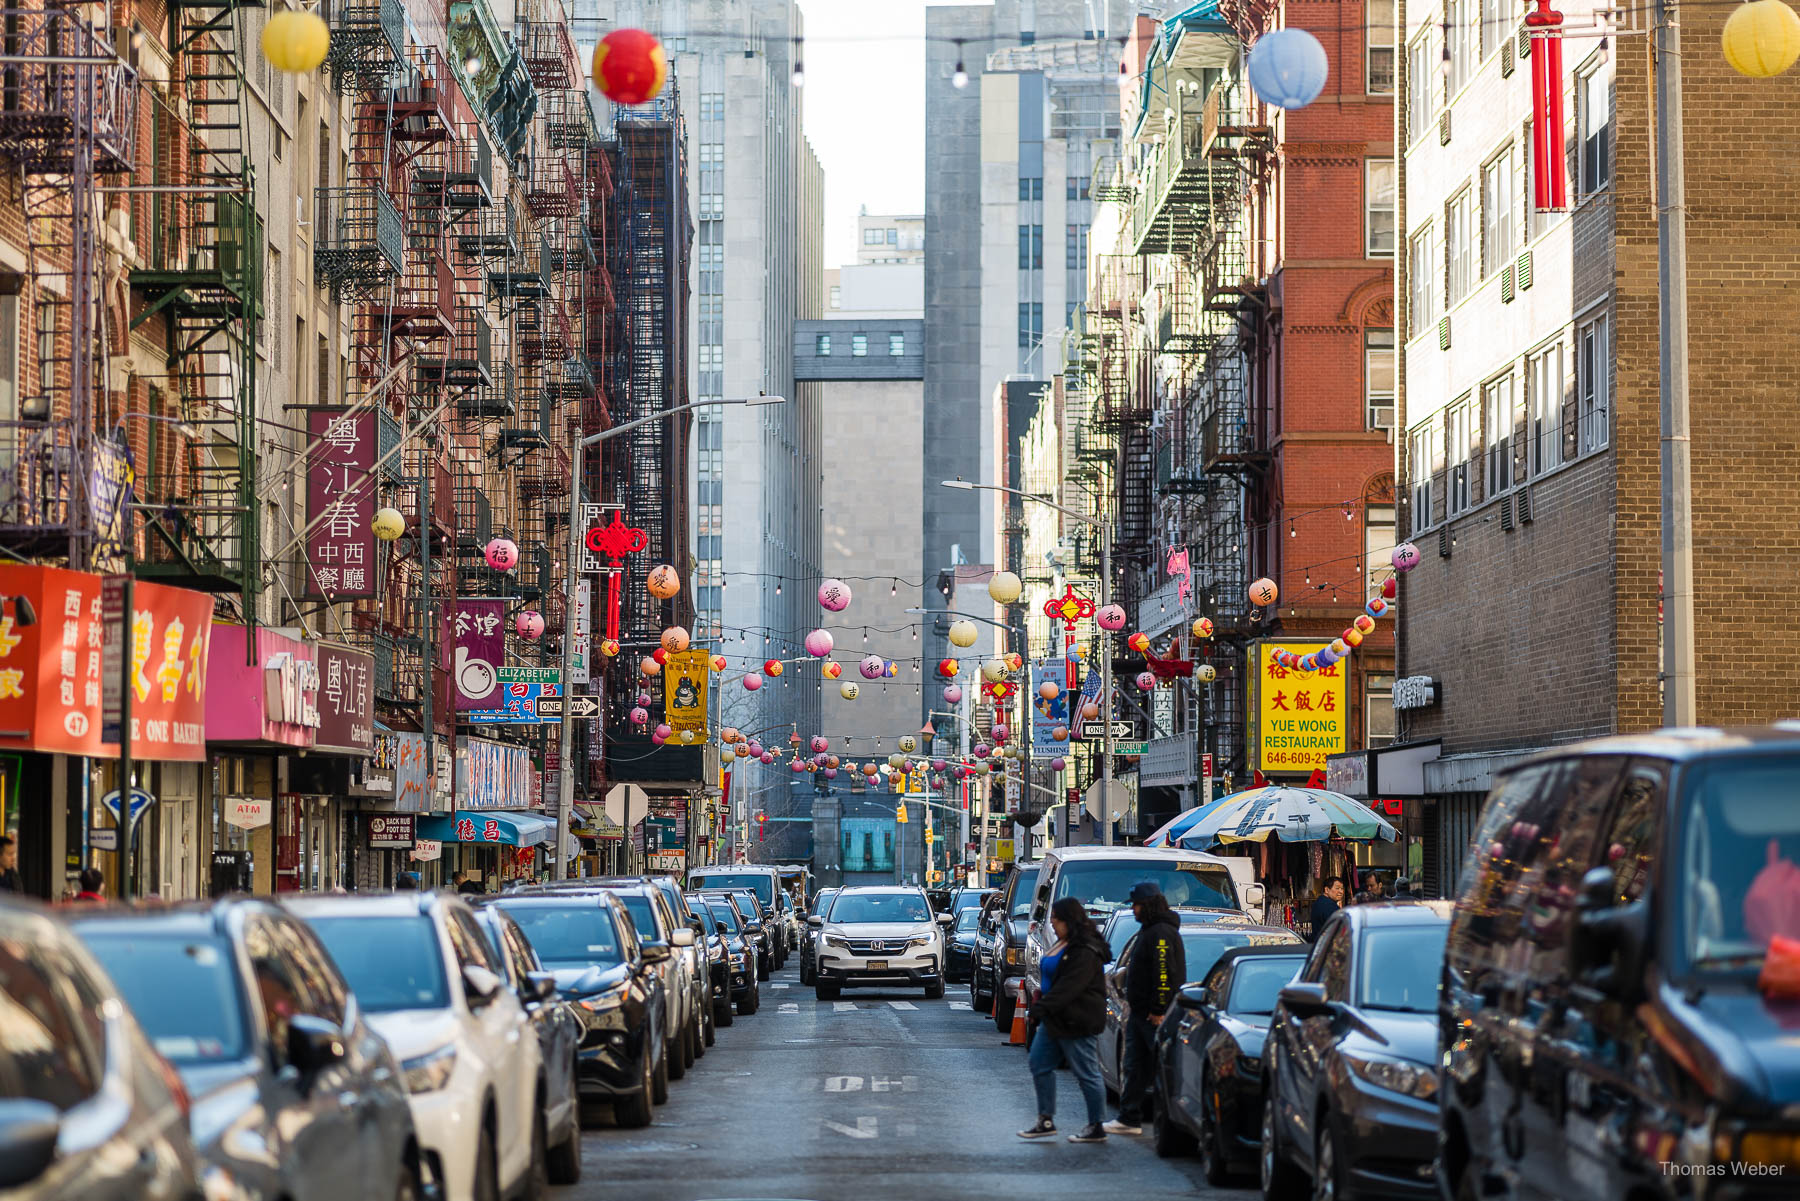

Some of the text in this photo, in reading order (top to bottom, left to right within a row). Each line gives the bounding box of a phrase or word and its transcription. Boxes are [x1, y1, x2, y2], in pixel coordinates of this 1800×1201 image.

[492, 545, 508, 564] 福
[1398, 549, 1413, 563] 和
[825, 587, 841, 605] 愛
[1259, 586, 1272, 602] 吉
[1105, 611, 1120, 623] 和
[499, 669, 550, 678] ELIZABETH
[866, 661, 880, 674] 和
[848, 686, 857, 697] 吉
[541, 702, 590, 711] ONE WAY
[1271, 689, 1337, 712] 大飯店
[146, 720, 169, 743] ONE
[1271, 720, 1337, 732] YUE WONG
[1115, 742, 1141, 750] ELIZABETH
[1265, 736, 1341, 748] RESTAURANT
[1033, 746, 1069, 754] FLUSHING
[1267, 752, 1330, 764] 646-609-23
[237, 804, 261, 814] ATM
[386, 817, 411, 825] BACK RUB
[456, 818, 500, 841] 德昌
[417, 843, 436, 851] ATM
[215, 855, 235, 864] ATM
[648, 856, 681, 869] TEA
